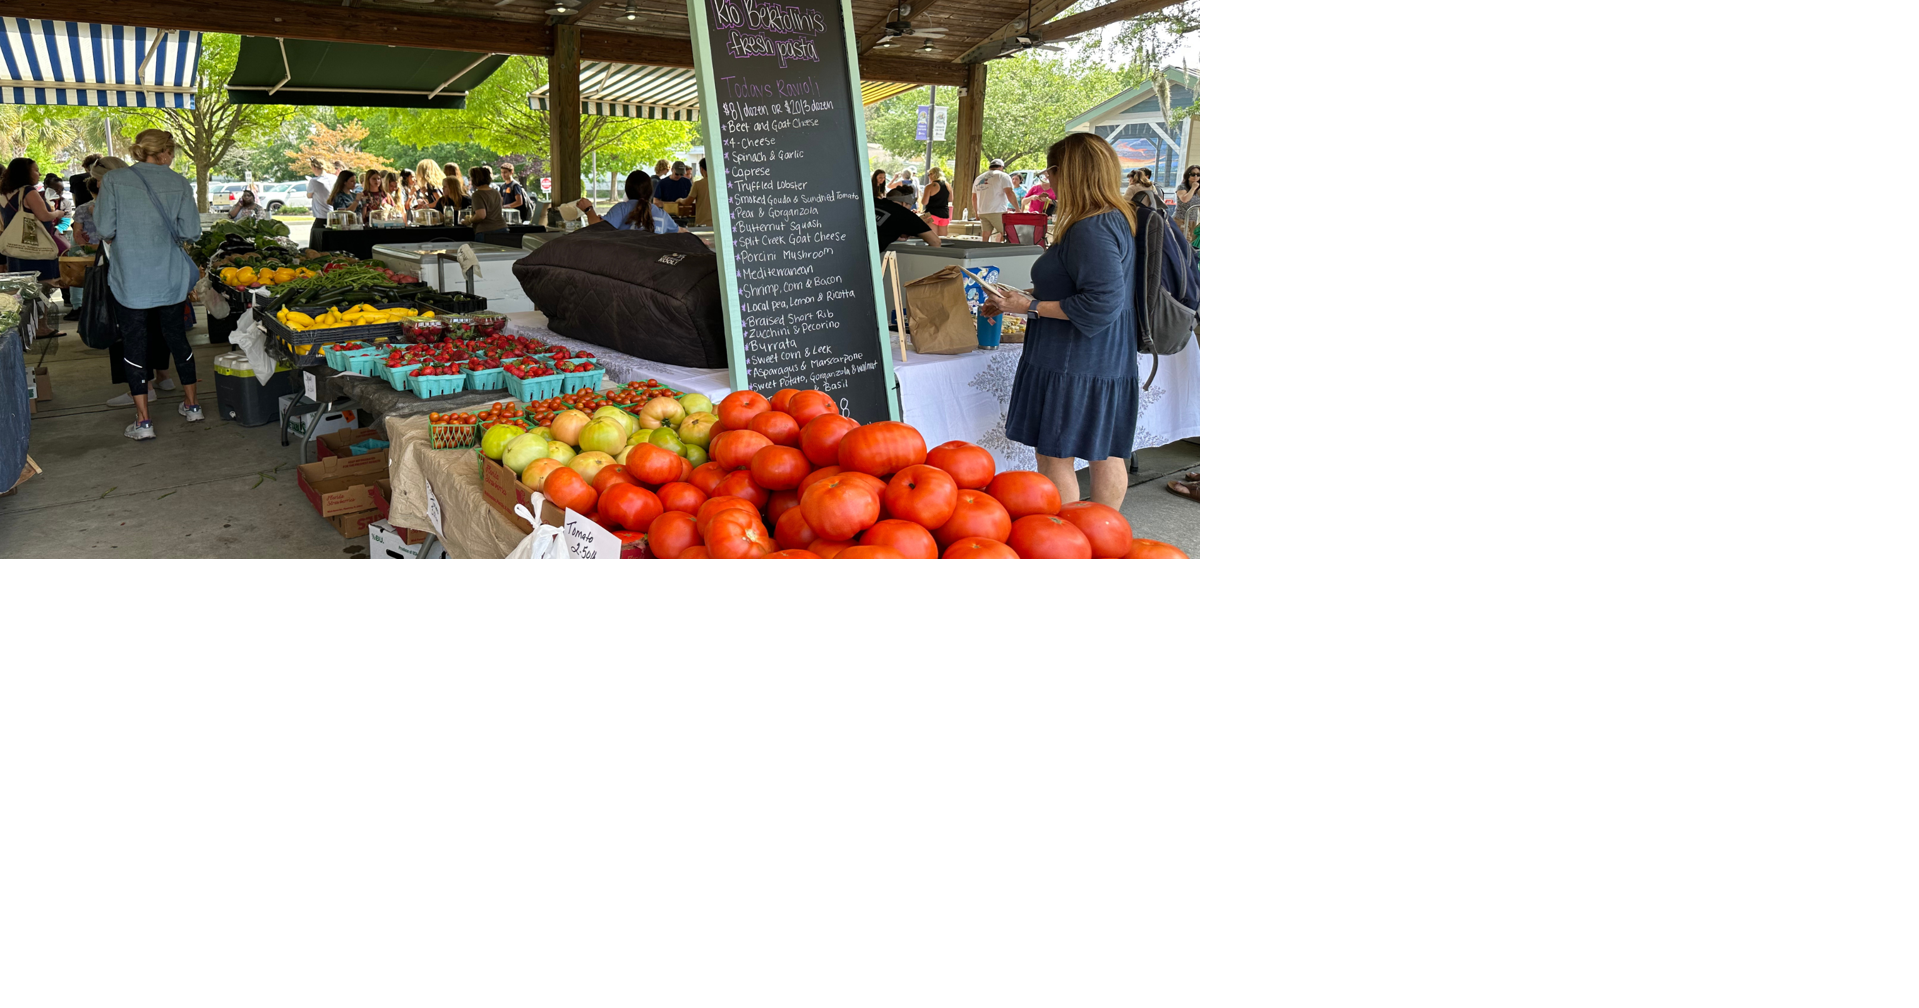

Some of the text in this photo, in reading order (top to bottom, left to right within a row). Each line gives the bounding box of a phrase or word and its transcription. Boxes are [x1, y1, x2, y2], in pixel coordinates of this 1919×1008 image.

[731, 31, 818, 66] fresh pasta
[720, 76, 820, 98] Todays Ravioli
[811, 99, 834, 113] dozen
[727, 118, 820, 133] Beet and Goat Cheese
[731, 149, 804, 165] Spinach & Garlic
[731, 166, 771, 181] Caprese
[734, 180, 808, 193] Truffled Lobster
[734, 194, 766, 206] Smoked
[767, 194, 792, 205] Gouda
[800, 190, 835, 204] Sundried
[836, 190, 860, 201] Tomato
[734, 206, 819, 222] Pear & Gorganzola
[736, 219, 822, 235] Butternut Squash
[738, 230, 848, 250] Split Creek Goat Cheese
[740, 247, 834, 264] Porcini Mushroom
[742, 264, 814, 281] Mediterranean
[783, 281, 803, 294] Corn
[805, 278, 813, 289] &
[814, 274, 842, 287] Bacon
[746, 300, 770, 313] Local
[789, 296, 815, 308] Lemon
[817, 292, 824, 303] &
[826, 288, 856, 302] Ricotta
[746, 308, 834, 328] Braised Short Rib
[748, 327, 791, 340] Zucchini
[793, 325, 801, 335] &
[750, 337, 798, 353] Burrata
[751, 344, 834, 367] Sweet Corn & Leek
[753, 362, 800, 379] Asparagus
[800, 361, 807, 371] &
[753, 381, 778, 392] Sweet
[851, 365, 857, 375] &
[822, 378, 849, 392] Basil
[566, 521, 594, 543] Tomato
